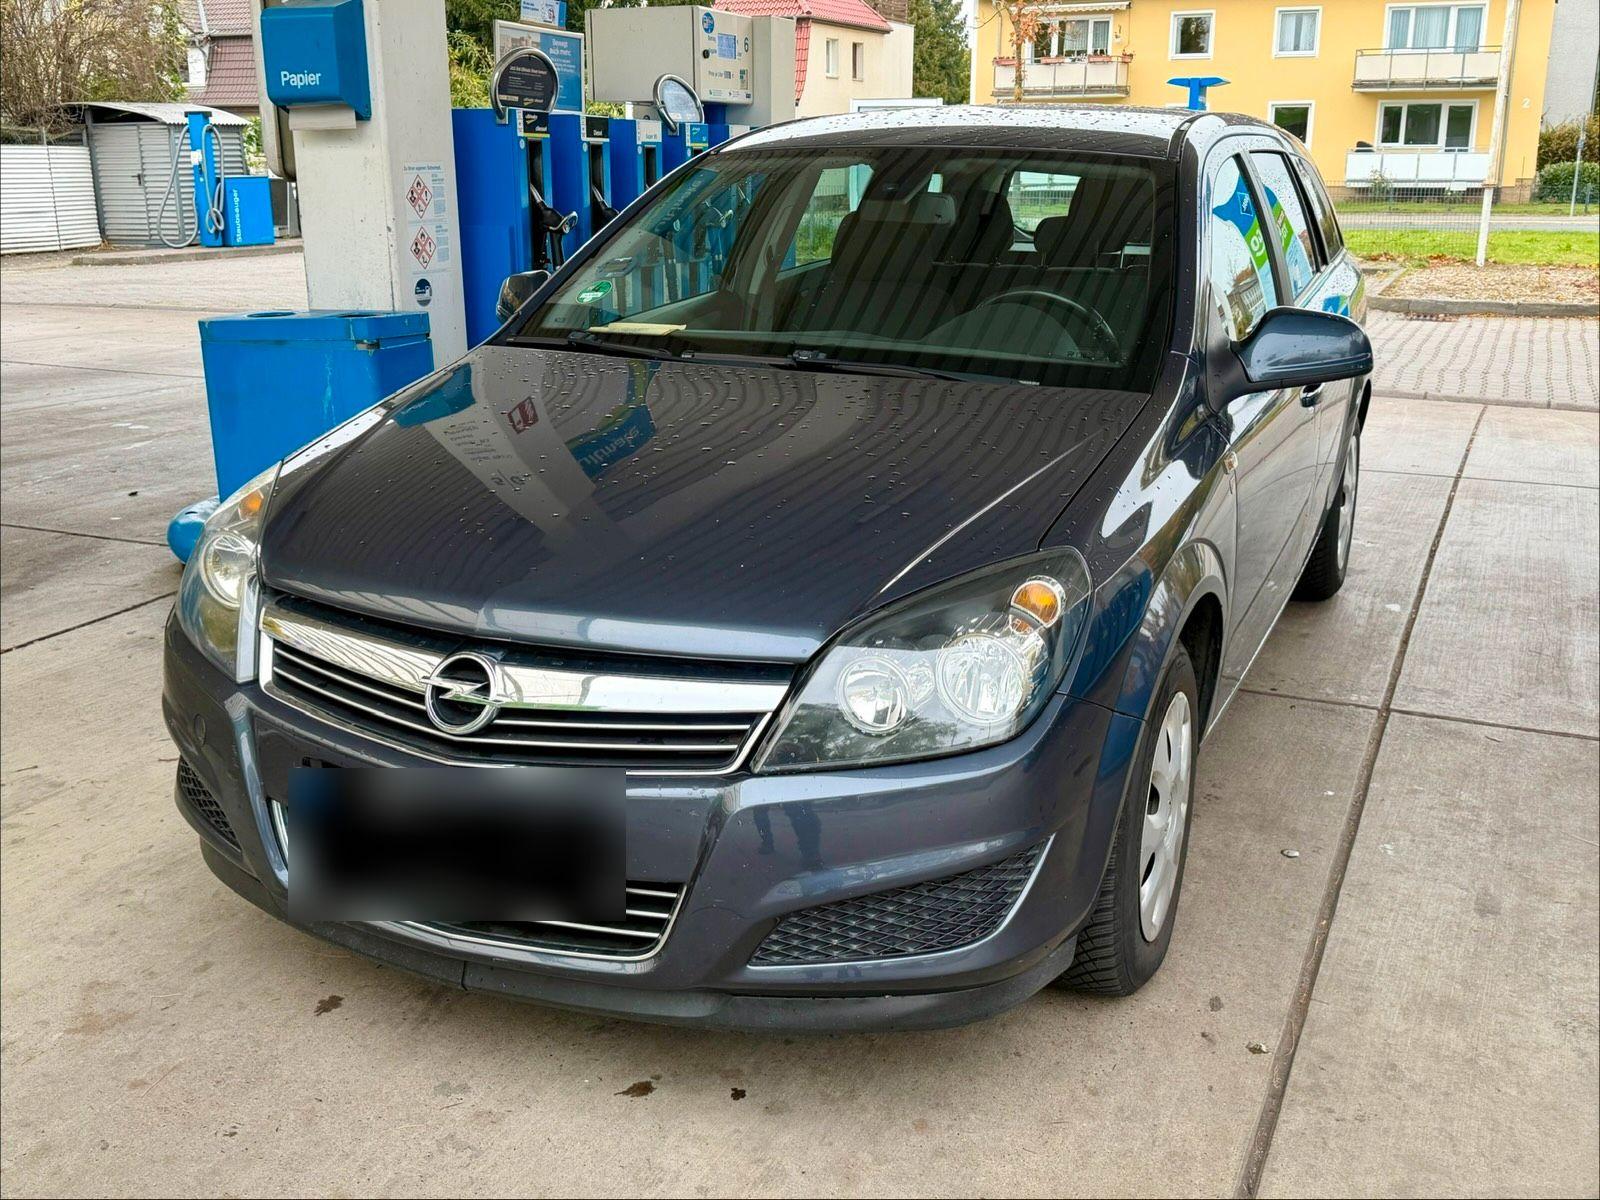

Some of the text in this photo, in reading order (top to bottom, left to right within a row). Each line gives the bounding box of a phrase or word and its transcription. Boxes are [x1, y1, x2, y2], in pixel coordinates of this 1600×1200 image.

[744, 37, 749, 53] 6
[280, 70, 322, 89] Papier
[1522, 98, 1531, 109] 2
